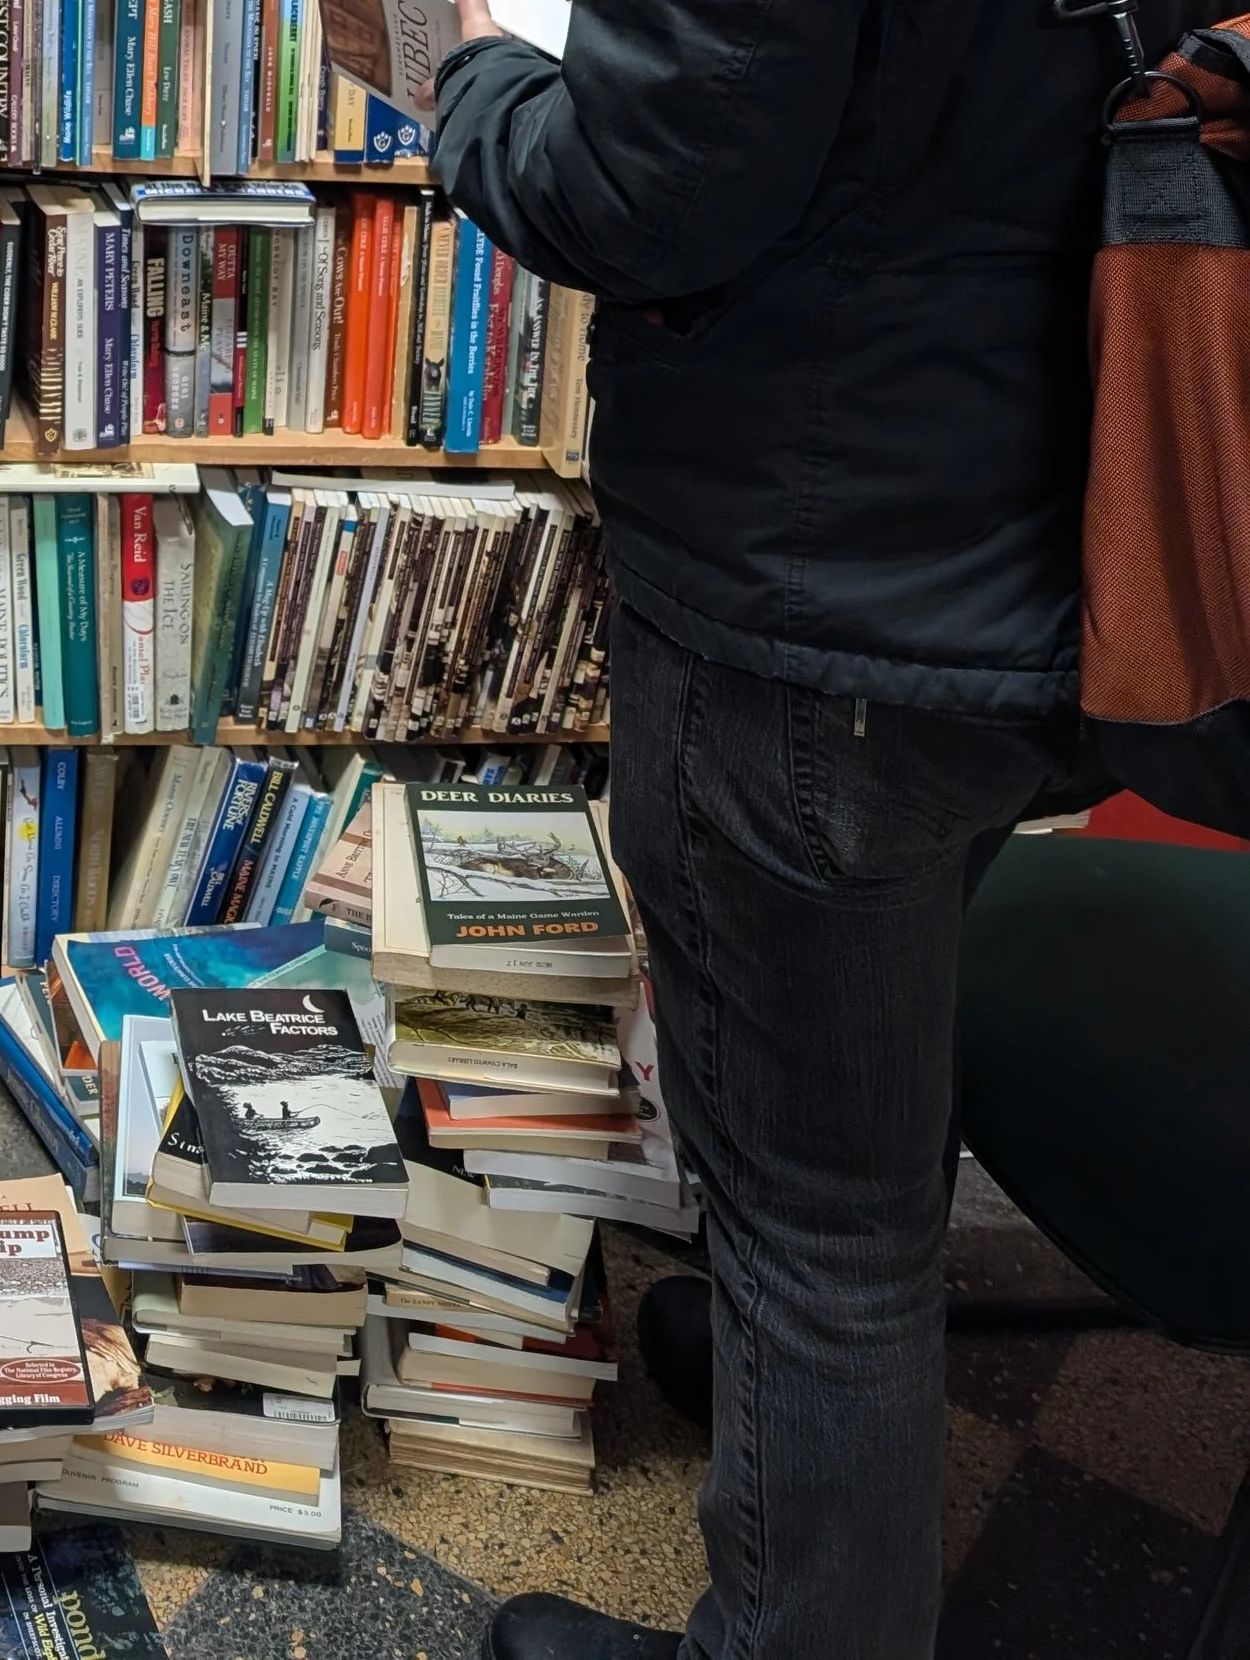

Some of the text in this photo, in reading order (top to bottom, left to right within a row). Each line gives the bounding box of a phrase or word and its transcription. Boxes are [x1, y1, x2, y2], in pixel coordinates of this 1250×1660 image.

[105, 233, 115, 311] MARY PETERS
[217, 244, 227, 281] MY WAY
[226, 245, 236, 279] OUTTA
[147, 258, 164, 317] FALLING
[180, 234, 193, 333] Downeast
[133, 506, 146, 563] Van Reid
[163, 580, 175, 630] THE ICE
[179, 563, 191, 644] SAILING ON
[250, 771, 283, 844] BILL CALDWELL
[420, 790, 574, 804] DEER DIARIES
[51, 762, 66, 922] COLBY ALUMNI DIRECTORY
[456, 922, 598, 938] JOHN FORD
[498, 912, 527, 920] Maine
[530, 912, 559, 920] Game
[562, 910, 600, 918] Warden
[110, 946, 172, 1003] WORLD
[202, 1009, 325, 1024] LAKE BEATRICE
[270, 1023, 338, 1036] FACTORS
[34, 1394, 60, 1403] Film
[151, 1443, 268, 1475] SILVERBRAND
[61, 1469, 140, 1488] OUVENIR PROGRAM
[269, 1505, 322, 1518] PRICE $3.00
[52, 1590, 107, 1660] pond
